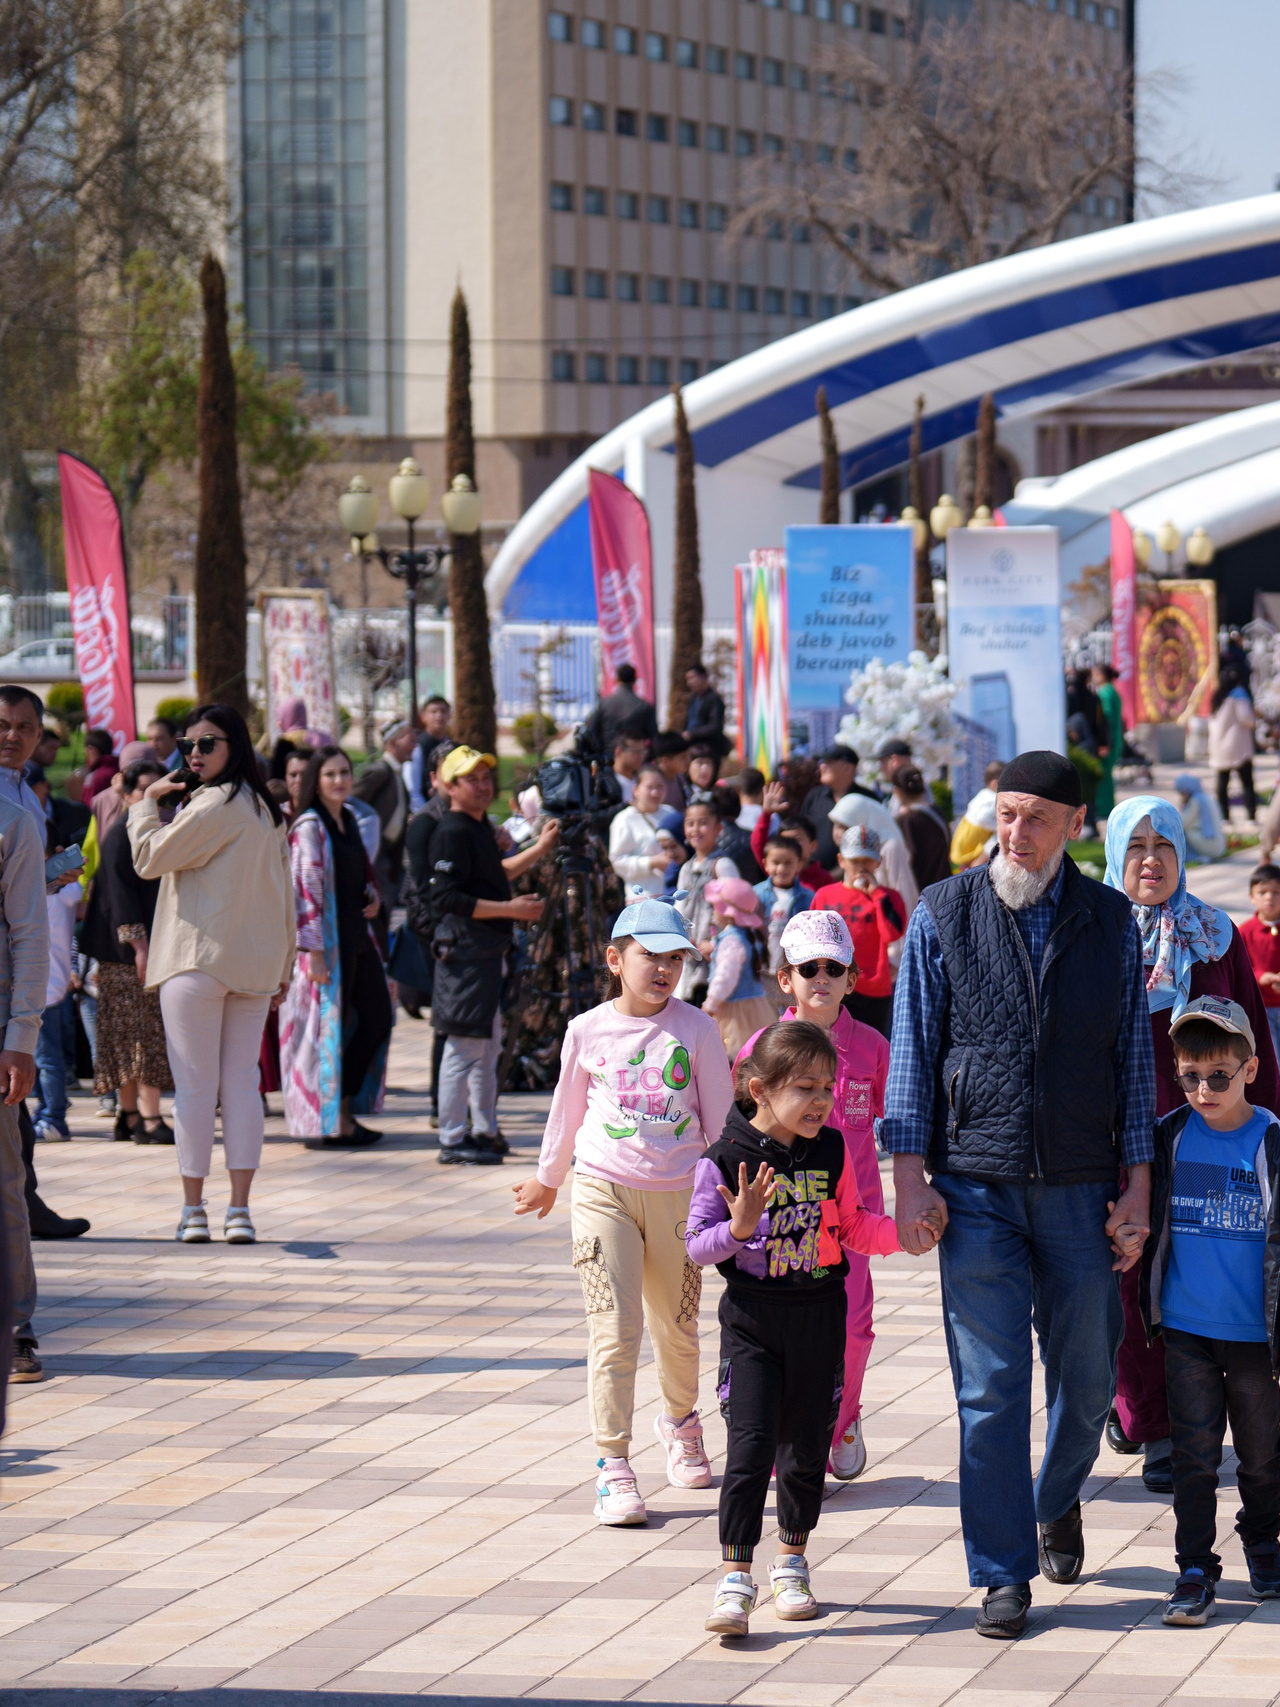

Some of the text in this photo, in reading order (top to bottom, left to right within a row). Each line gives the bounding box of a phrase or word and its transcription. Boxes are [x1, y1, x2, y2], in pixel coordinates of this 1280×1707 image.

[830, 565, 861, 581] Biz
[820, 588, 873, 607] sizga
[804, 610, 889, 629] shunday
[797, 632, 896, 651] deb javob
[796, 654, 867, 671] berami
[1180, 1197, 1194, 1207] GIVE
[1194, 1199, 1204, 1208] UP
